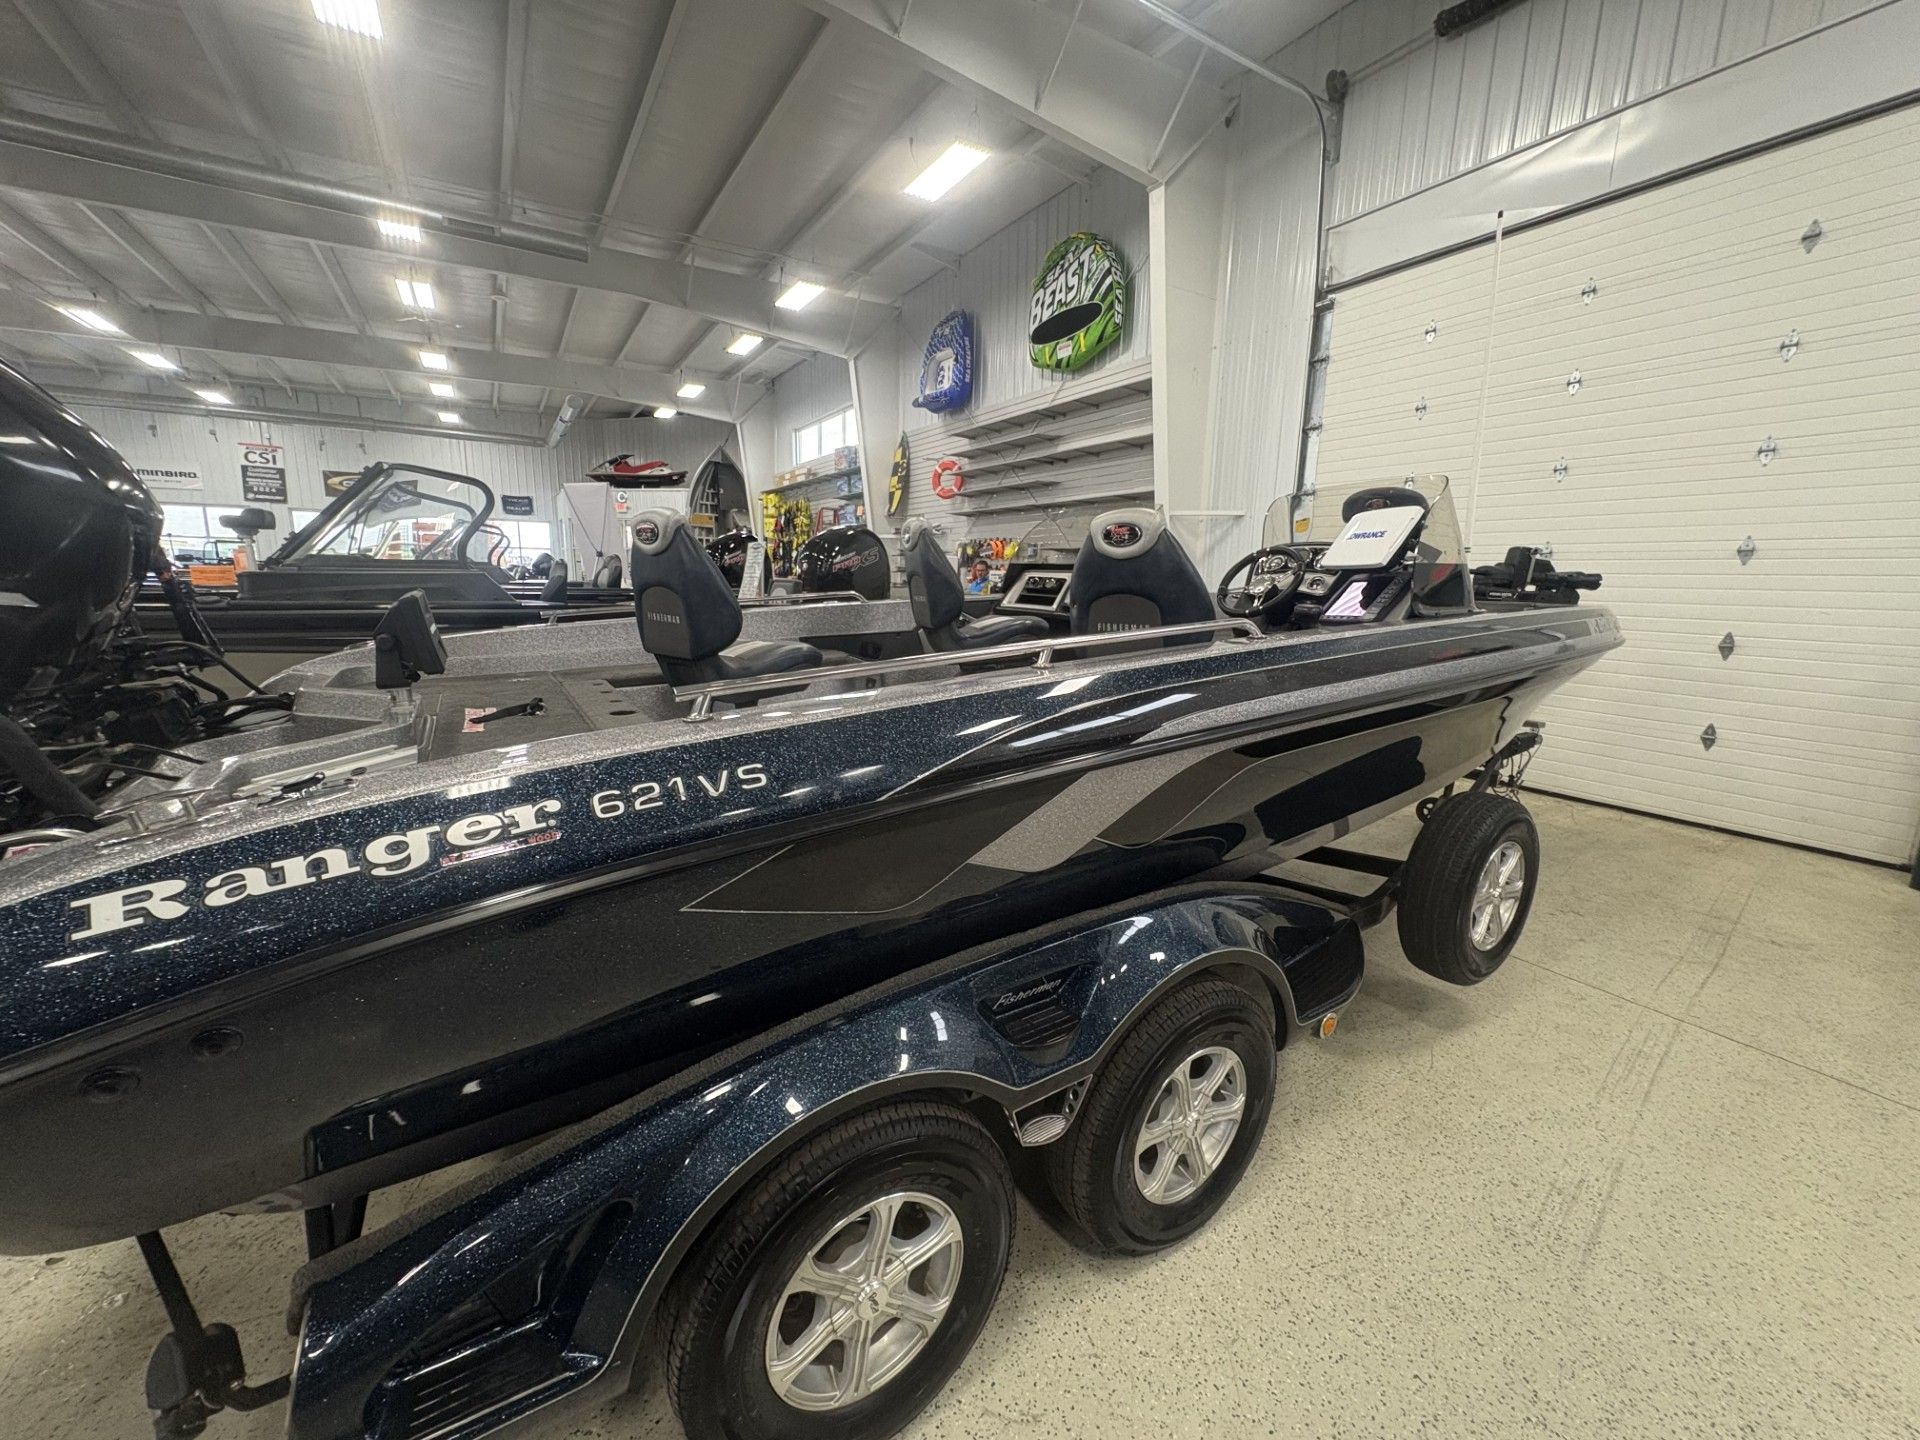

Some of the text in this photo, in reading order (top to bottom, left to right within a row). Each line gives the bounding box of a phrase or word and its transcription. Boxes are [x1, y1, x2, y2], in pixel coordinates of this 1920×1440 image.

[1044, 250, 1075, 288] SEA
[1029, 243, 1096, 336] BEAST
[1114, 288, 1123, 327] SEA
[244, 450, 277, 466] CSI
[69, 762, 769, 942] Ranger 621VS
